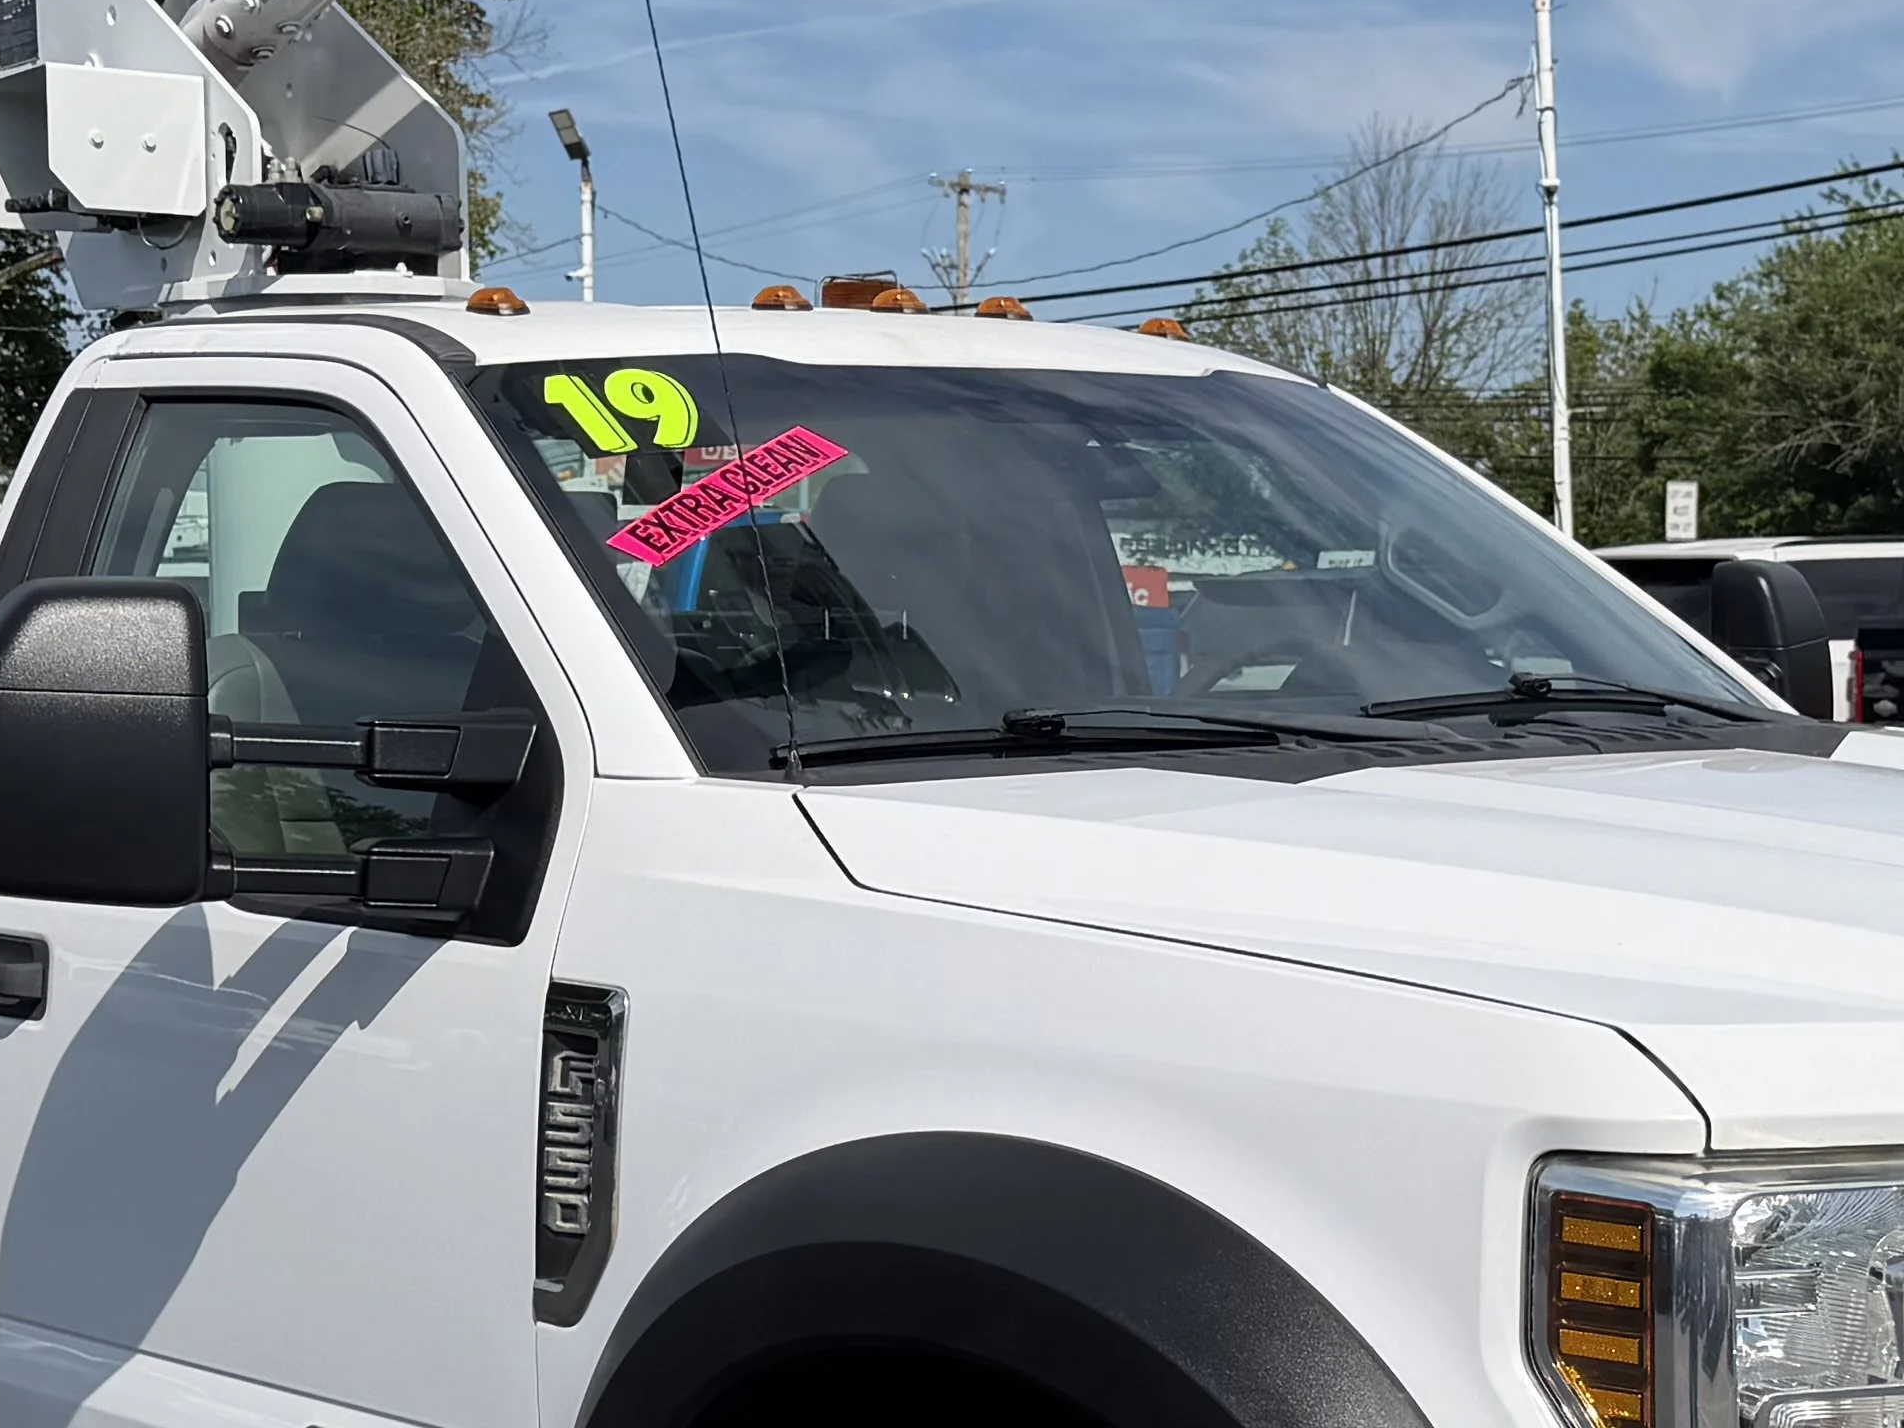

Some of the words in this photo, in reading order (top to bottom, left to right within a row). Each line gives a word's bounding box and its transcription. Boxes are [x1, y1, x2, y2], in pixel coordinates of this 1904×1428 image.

[544, 368, 699, 453] 19
[627, 483, 740, 554] EXTRA
[723, 433, 824, 496] CLEAN
